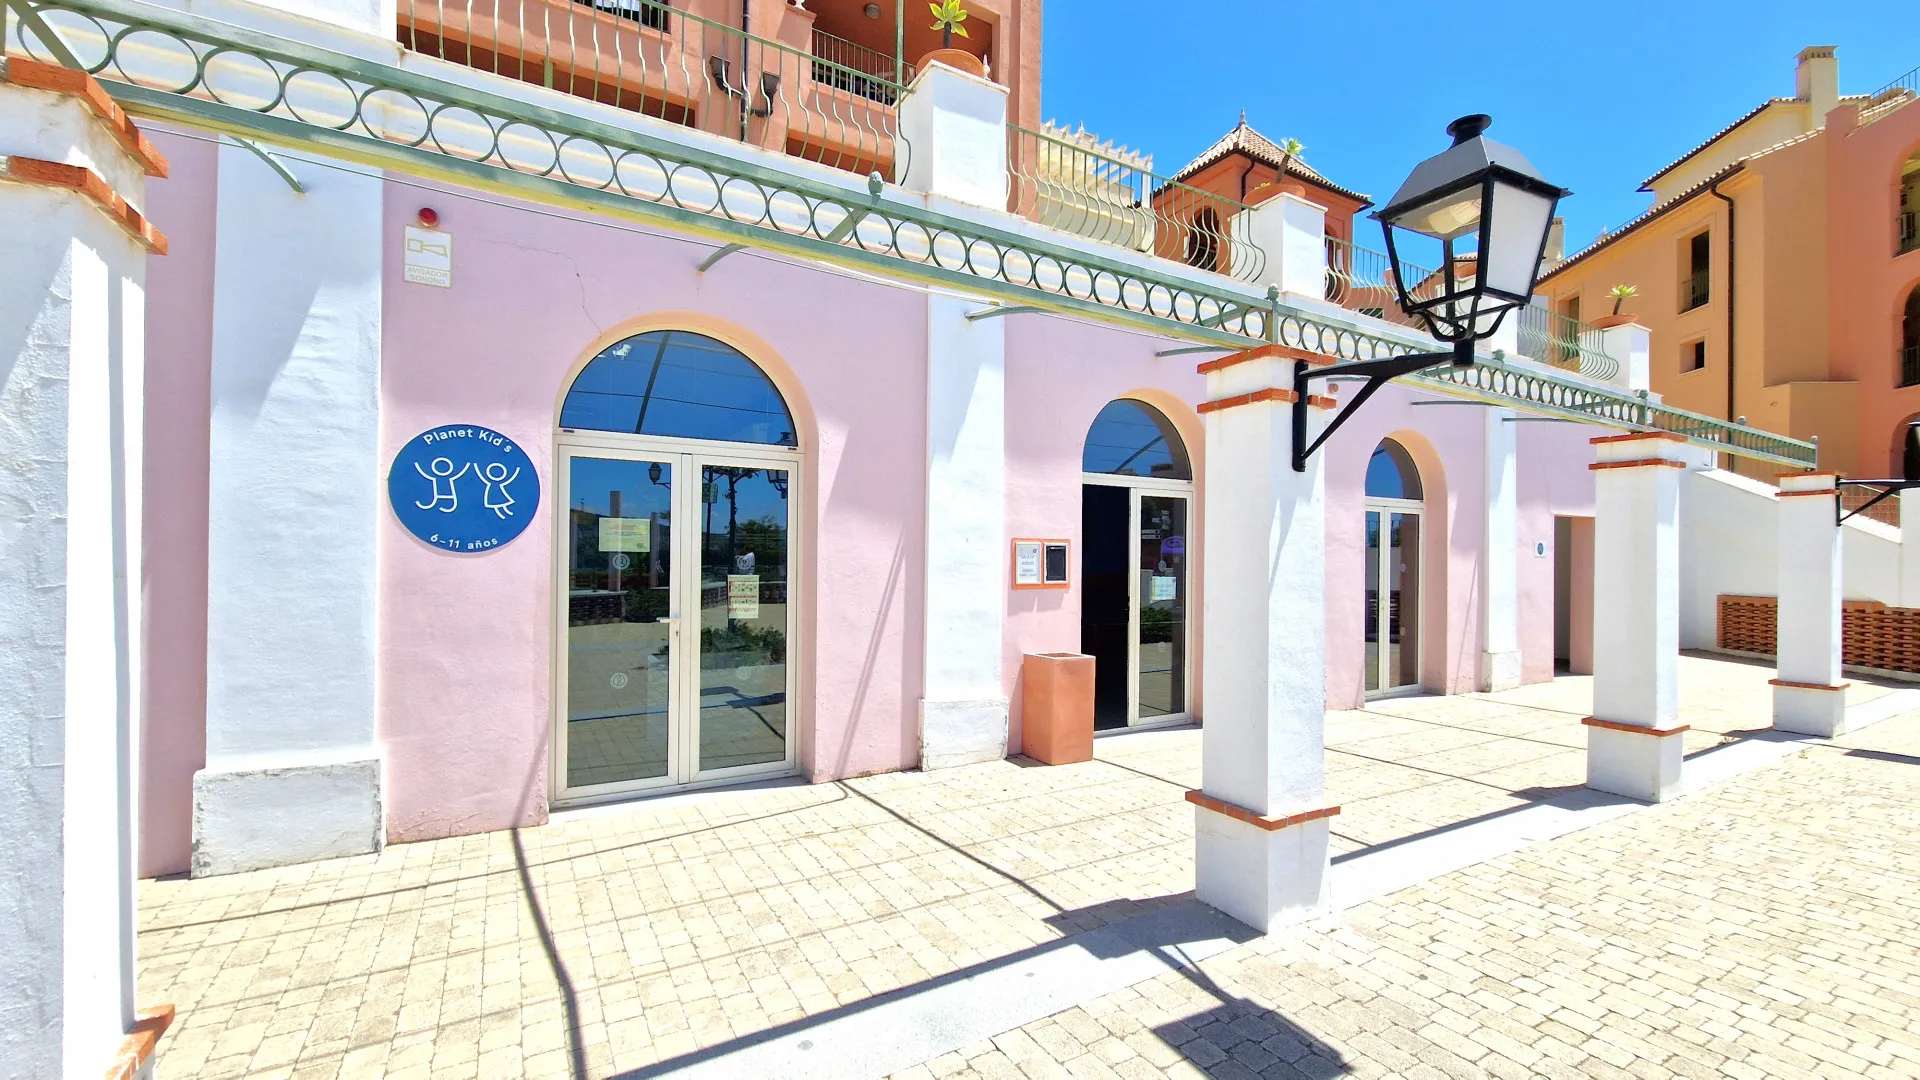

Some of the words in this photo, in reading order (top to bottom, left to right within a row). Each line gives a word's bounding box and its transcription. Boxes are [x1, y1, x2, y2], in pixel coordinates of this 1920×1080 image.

[407, 266, 448, 279] AVISADOR
[410, 274, 445, 286] SONORO
[423, 428, 473, 445] Planet
[467, 537, 498, 550] años
